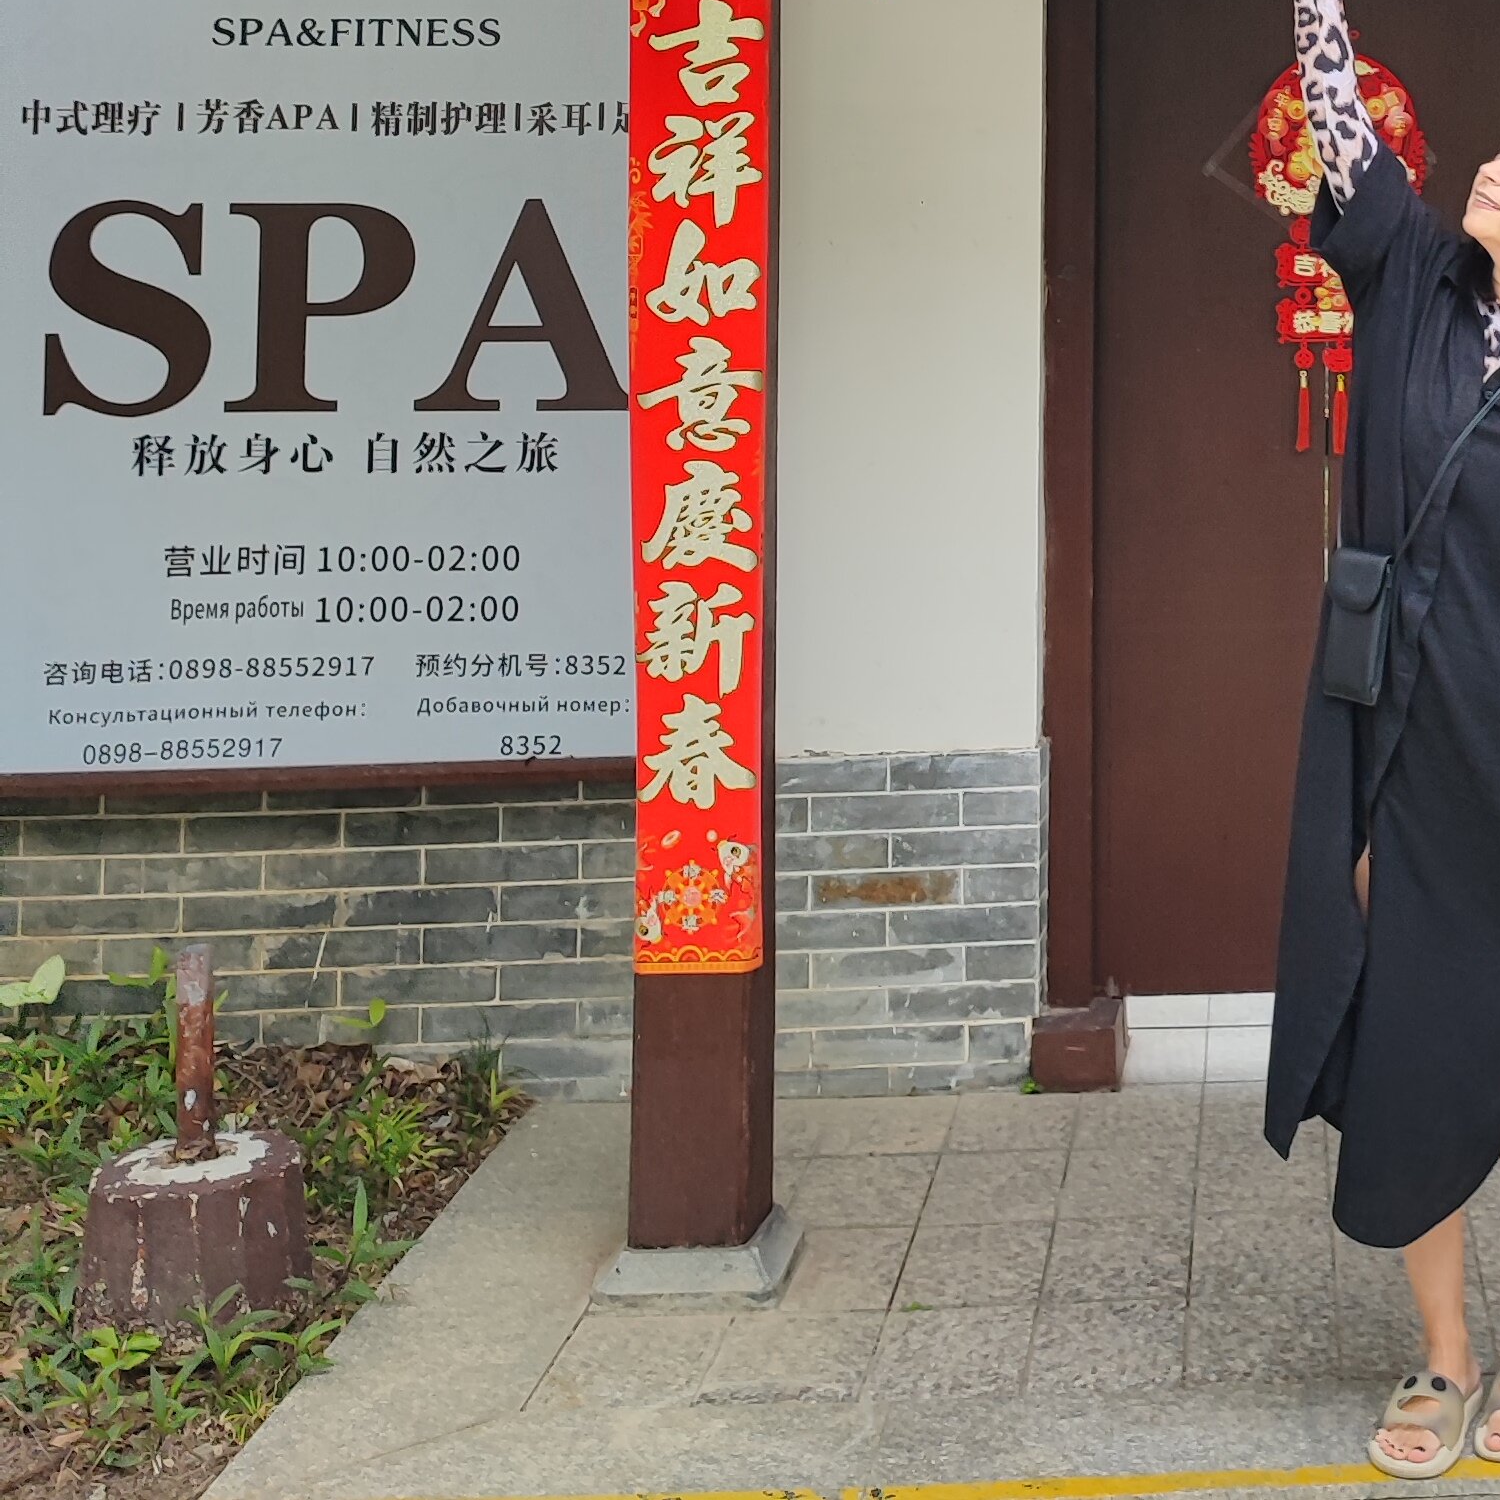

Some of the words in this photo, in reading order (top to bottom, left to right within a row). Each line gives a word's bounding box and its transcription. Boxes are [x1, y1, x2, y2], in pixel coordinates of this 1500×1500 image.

[211, 17, 501, 47] SPA&FITNESS
[22, 98, 161, 136] 中式理疗
[43, 197, 630, 417] SPA
[131, 432, 334, 477] 释放身心
[367, 431, 560, 475] 自然之旅
[164, 544, 306, 578] 营业时间
[317, 544, 521, 573] 10:00-02:00
[170, 598, 229, 625] Время
[234, 594, 304, 624] работы
[315, 595, 519, 623] 10:00-02:00
[48, 701, 258, 728] Консультационный
[266, 700, 367, 722] телефон:
[416, 694, 549, 717] Добавочный
[556, 698, 631, 717] номер:
[82, 737, 283, 765] 0898-88552917
[500, 734, 562, 756] 8352
